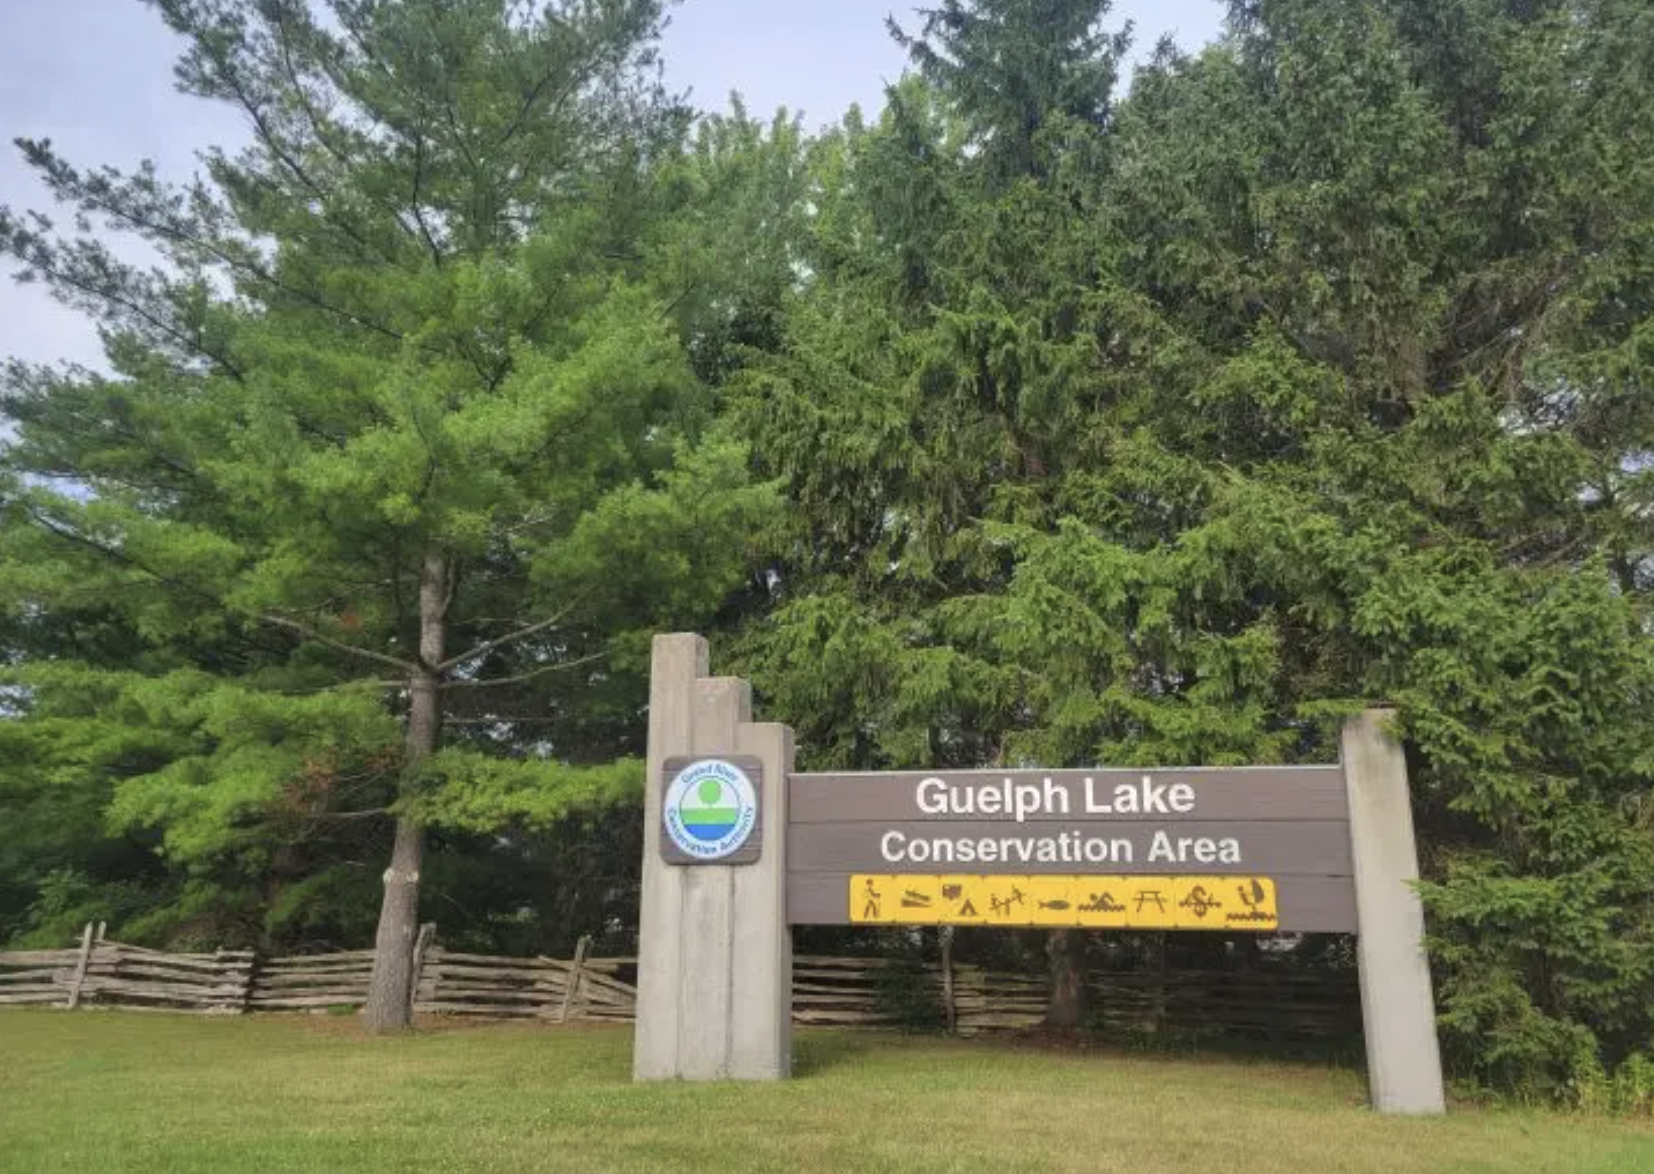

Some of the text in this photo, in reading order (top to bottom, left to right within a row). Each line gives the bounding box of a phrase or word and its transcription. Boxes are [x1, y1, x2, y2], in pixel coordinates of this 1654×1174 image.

[915, 777, 1195, 822] Guelph Lake
[880, 830, 1241, 864] Conservation Area
